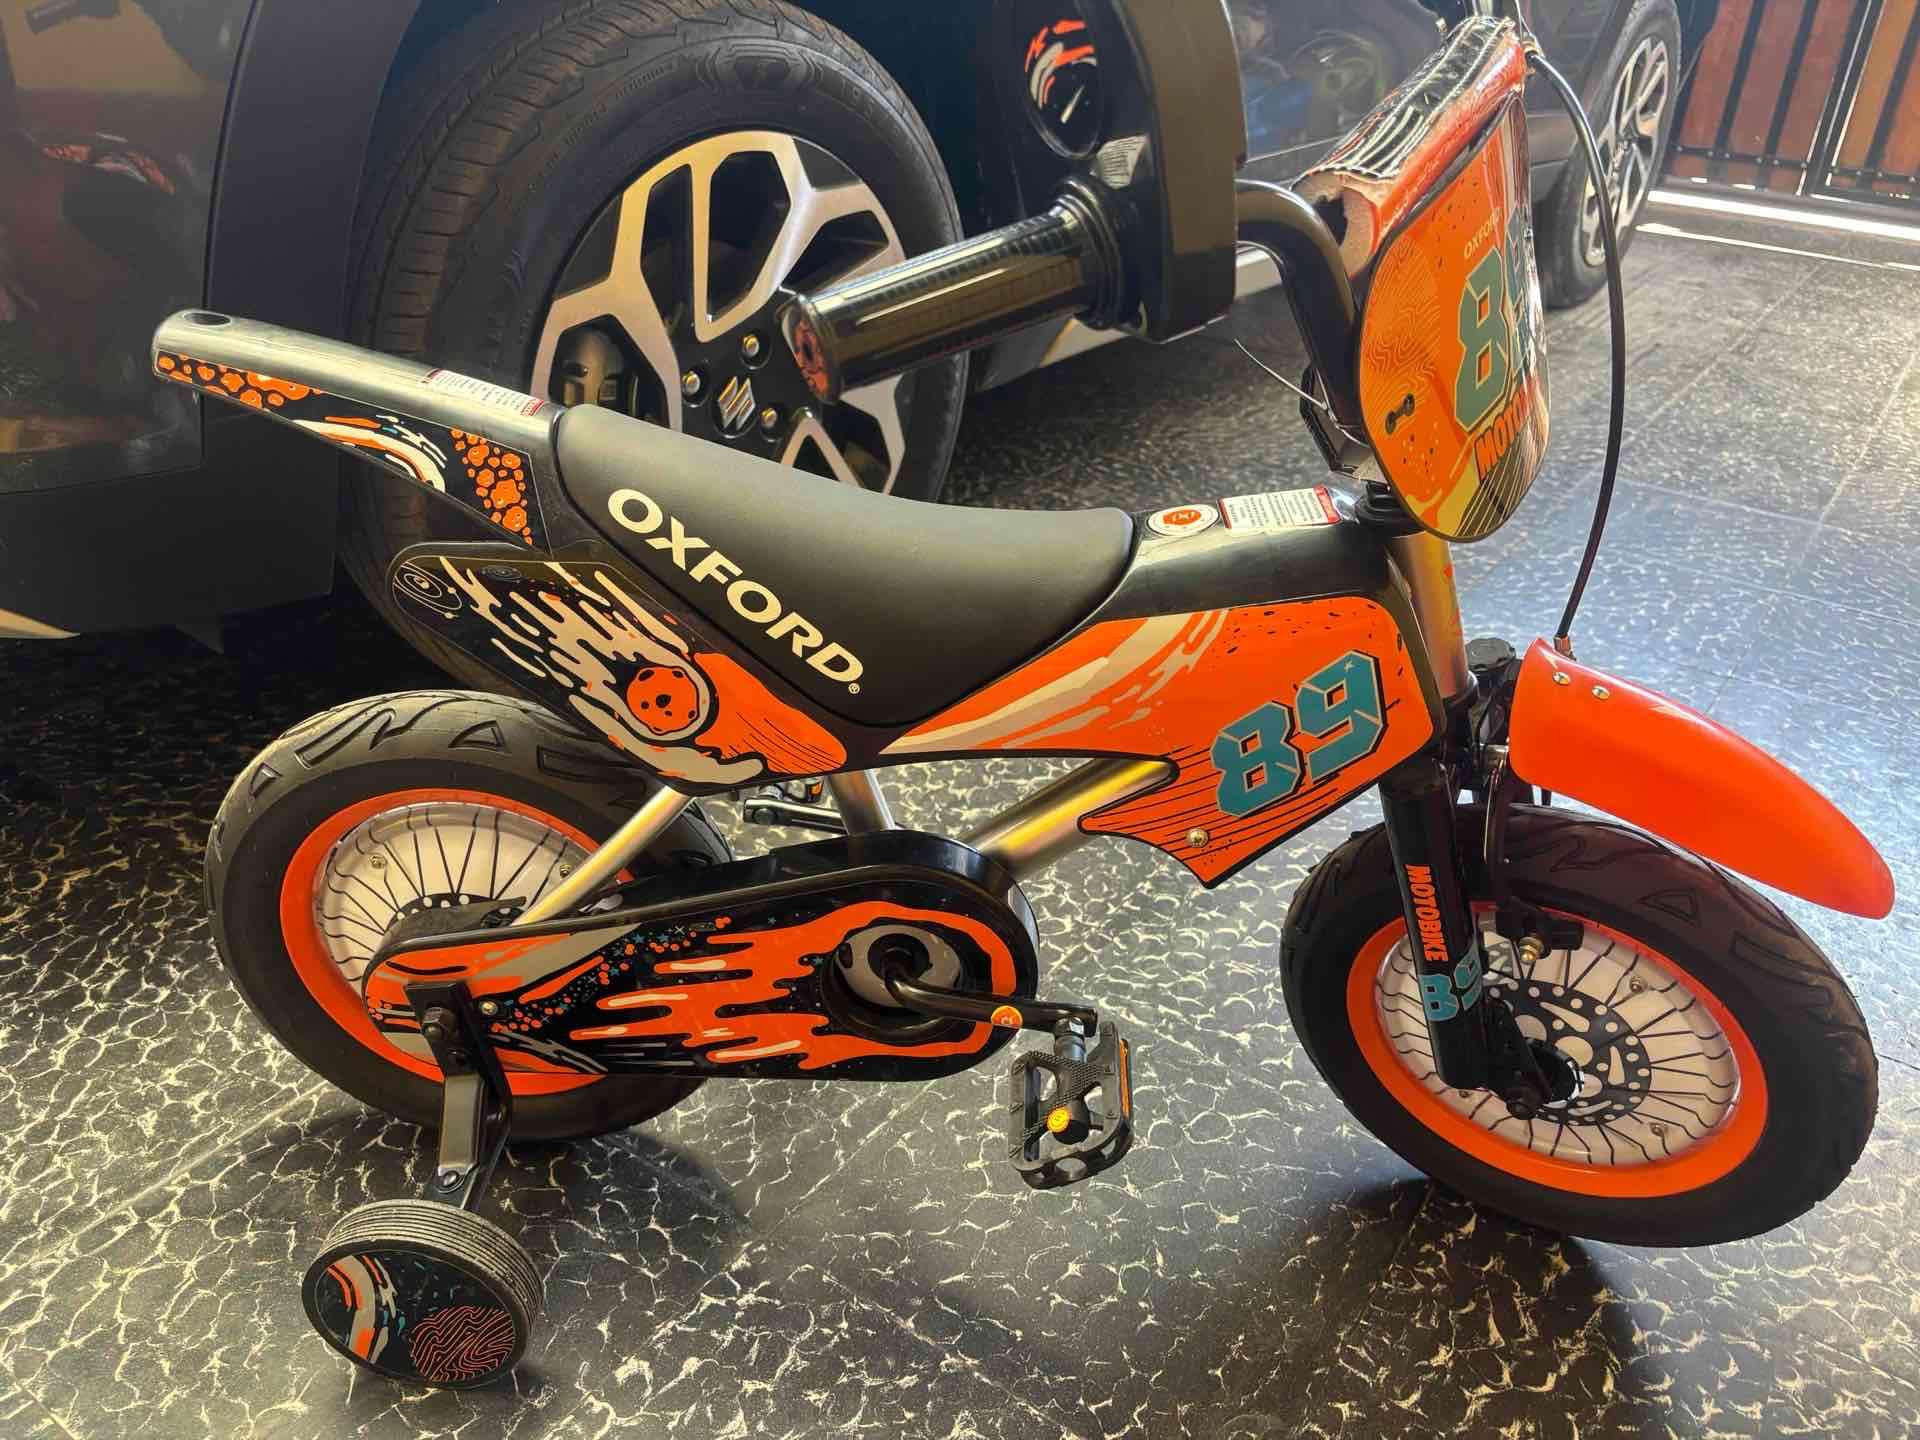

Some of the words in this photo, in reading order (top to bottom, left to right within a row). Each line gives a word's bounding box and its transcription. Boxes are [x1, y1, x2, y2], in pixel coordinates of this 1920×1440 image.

[1210, 650, 1388, 817] 89
[1405, 864, 1449, 962] MOTOBIKE
[1418, 952, 1482, 1022] 89
